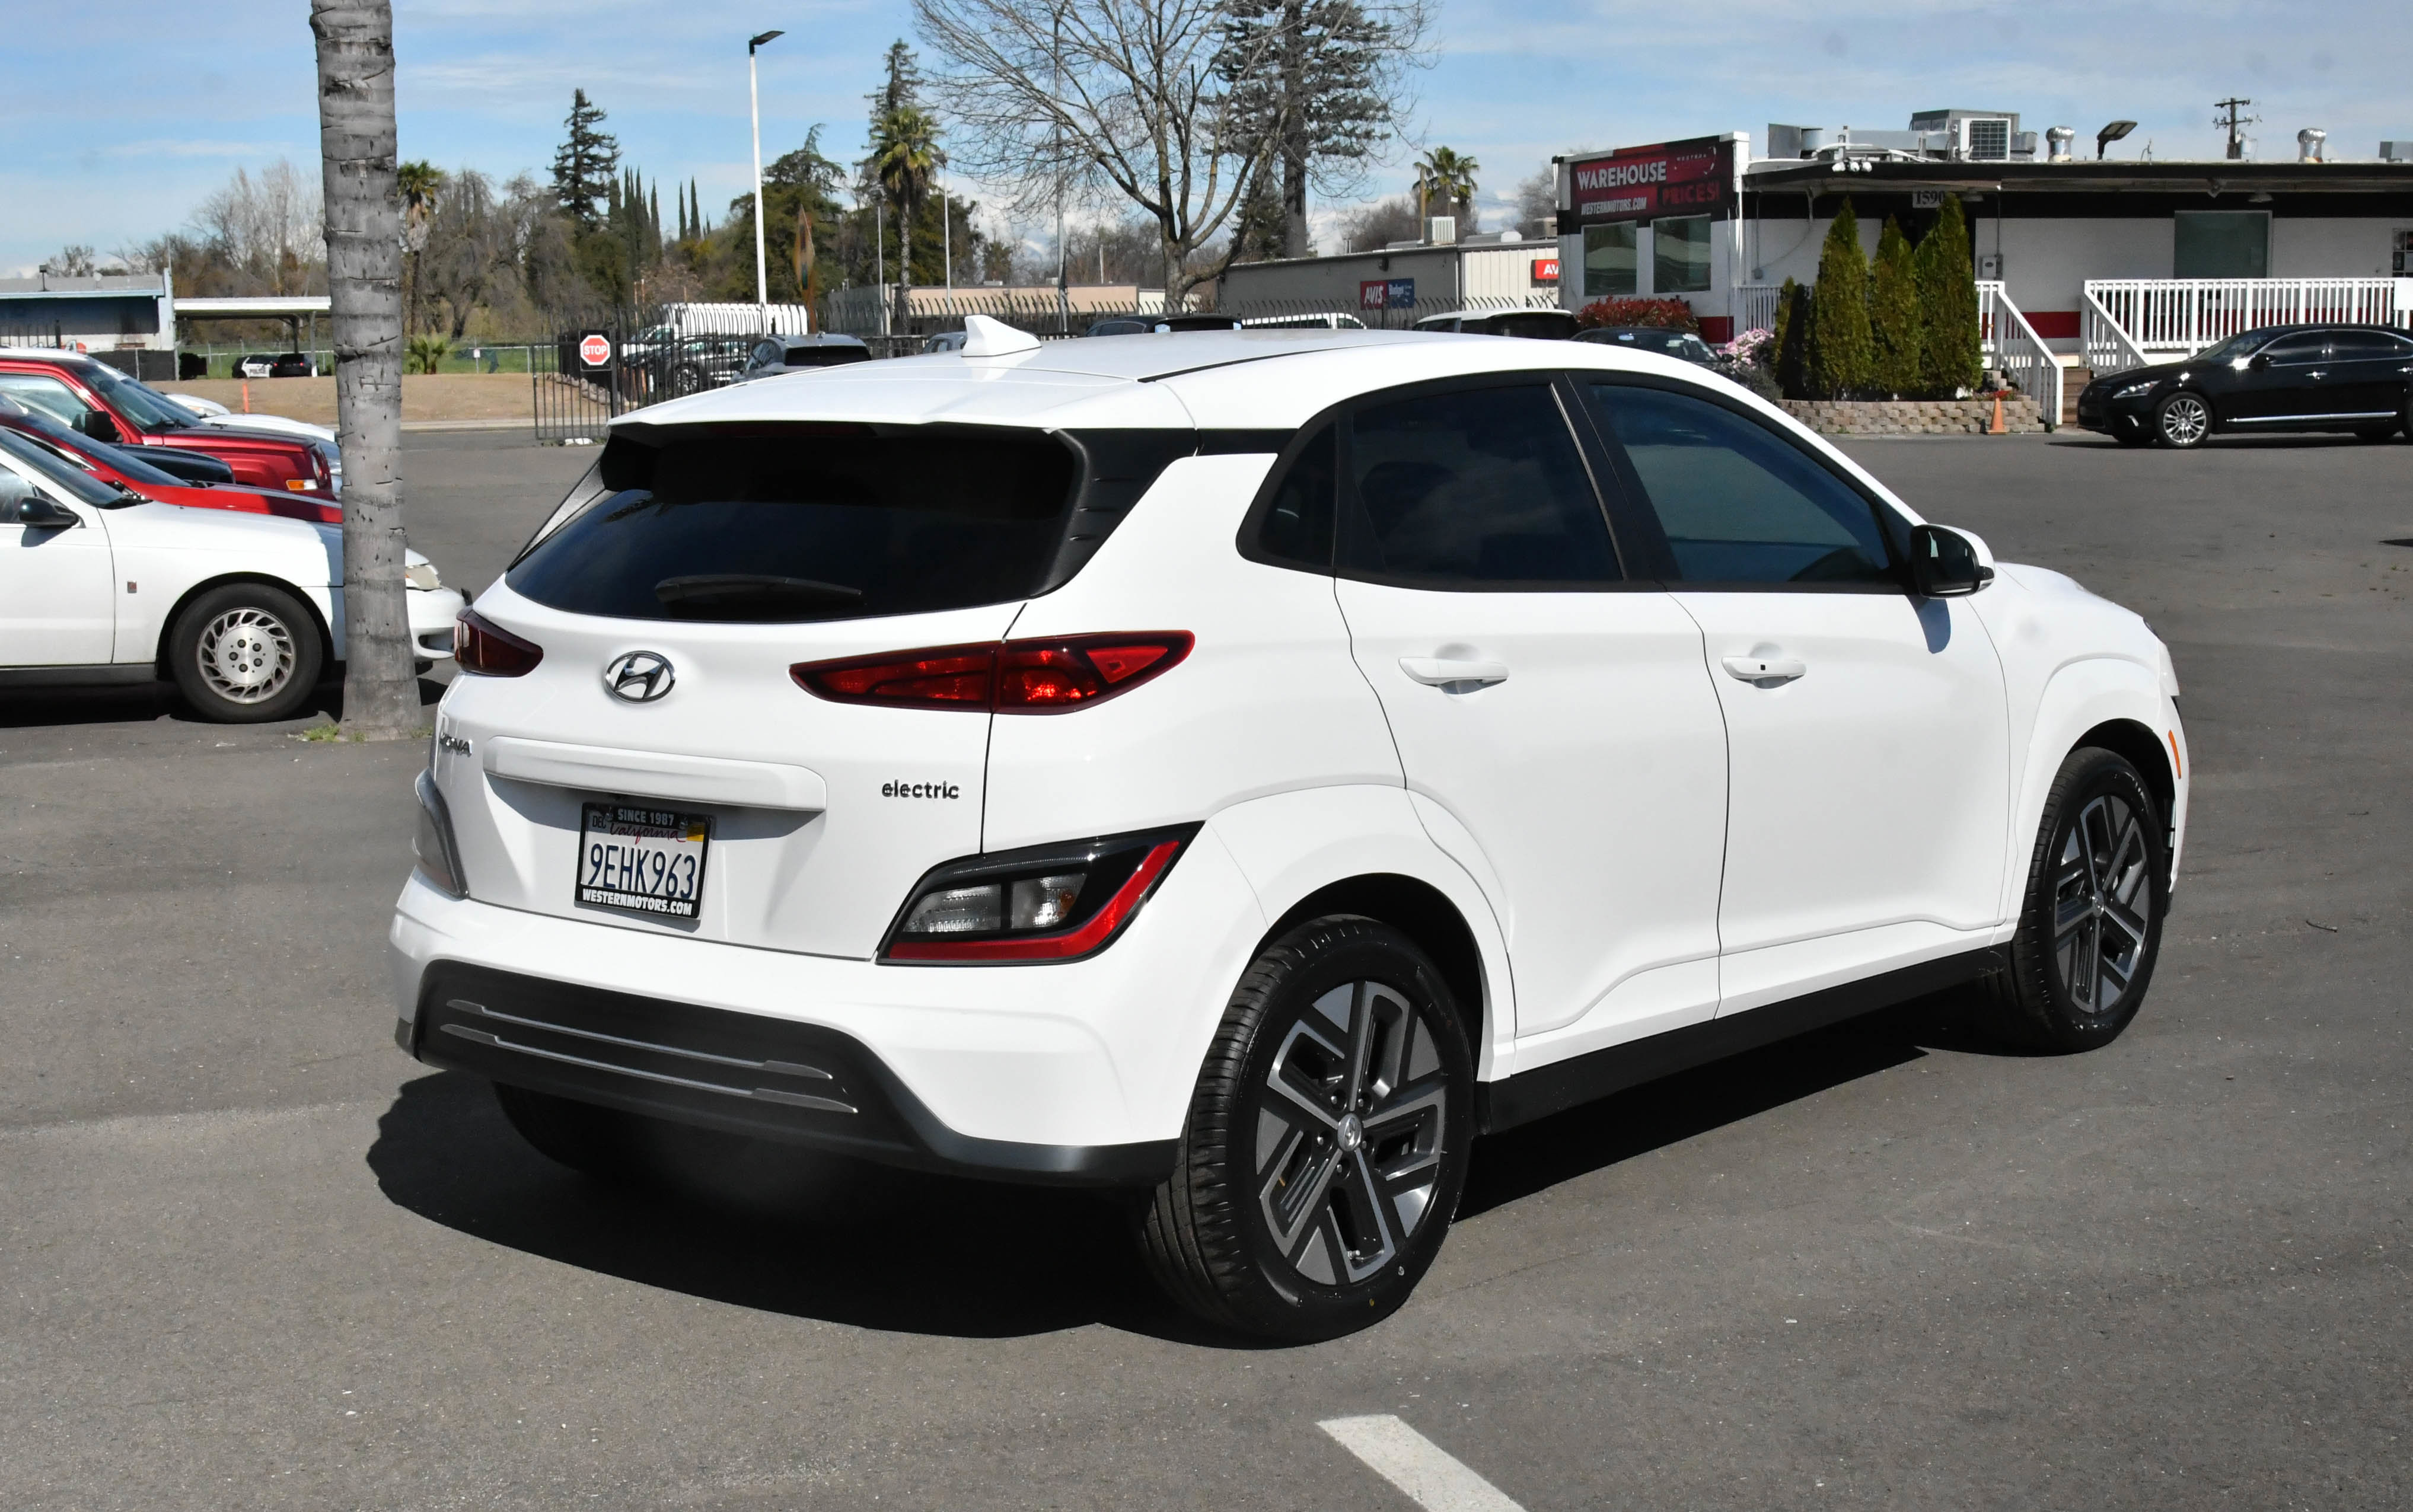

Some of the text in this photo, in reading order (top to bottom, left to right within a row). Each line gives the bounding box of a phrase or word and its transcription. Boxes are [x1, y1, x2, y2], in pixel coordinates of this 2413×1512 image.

[1577, 161, 1667, 191] WAREHOUSE
[1580, 197, 1647, 216] WESTERNMOTORS.COM
[1365, 285, 1384, 304] AVIS
[584, 345, 607, 355] STOP
[881, 779, 960, 799] electric
[617, 808, 674, 826] SINCE 1987
[588, 843, 696, 899] 9EHK963
[582, 888, 693, 916] WESTERNMOTORS.COM
